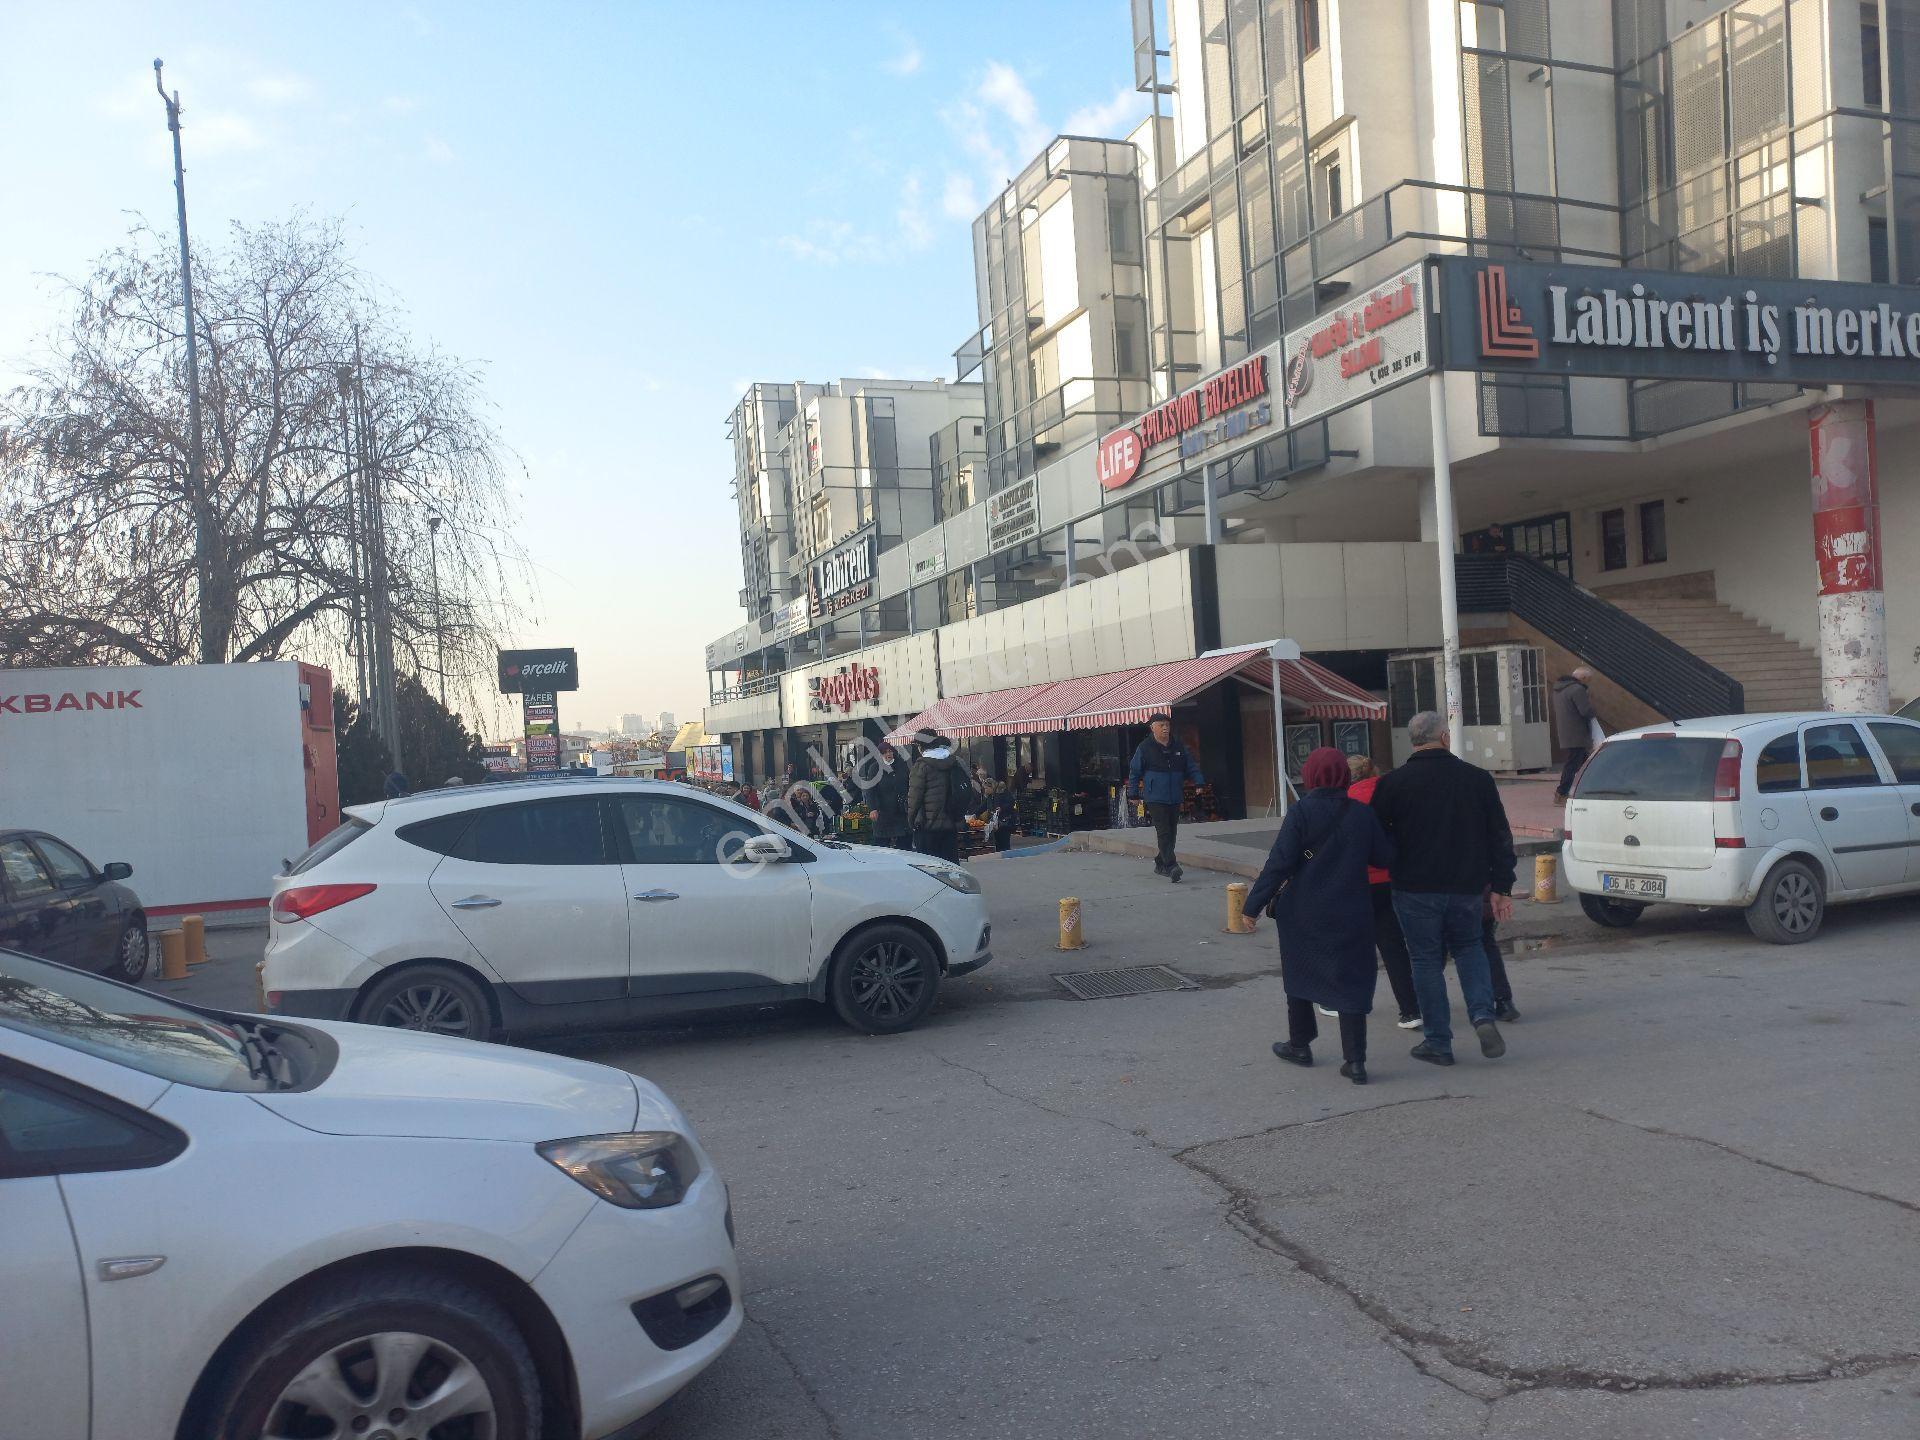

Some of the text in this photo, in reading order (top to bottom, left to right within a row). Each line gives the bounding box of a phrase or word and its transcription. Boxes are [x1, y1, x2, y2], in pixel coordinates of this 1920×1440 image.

[1549, 283, 1736, 351] Labirent
[1744, 289, 1781, 365] iş
[1100, 435, 1135, 481] LIFE
[820, 534, 870, 599] Labirent
[521, 660, 568, 677] arçelik
[524, 693, 553, 702] ZAFER
[530, 756, 556, 764] Optik
[1609, 877, 1662, 892] 06 AG 2084
